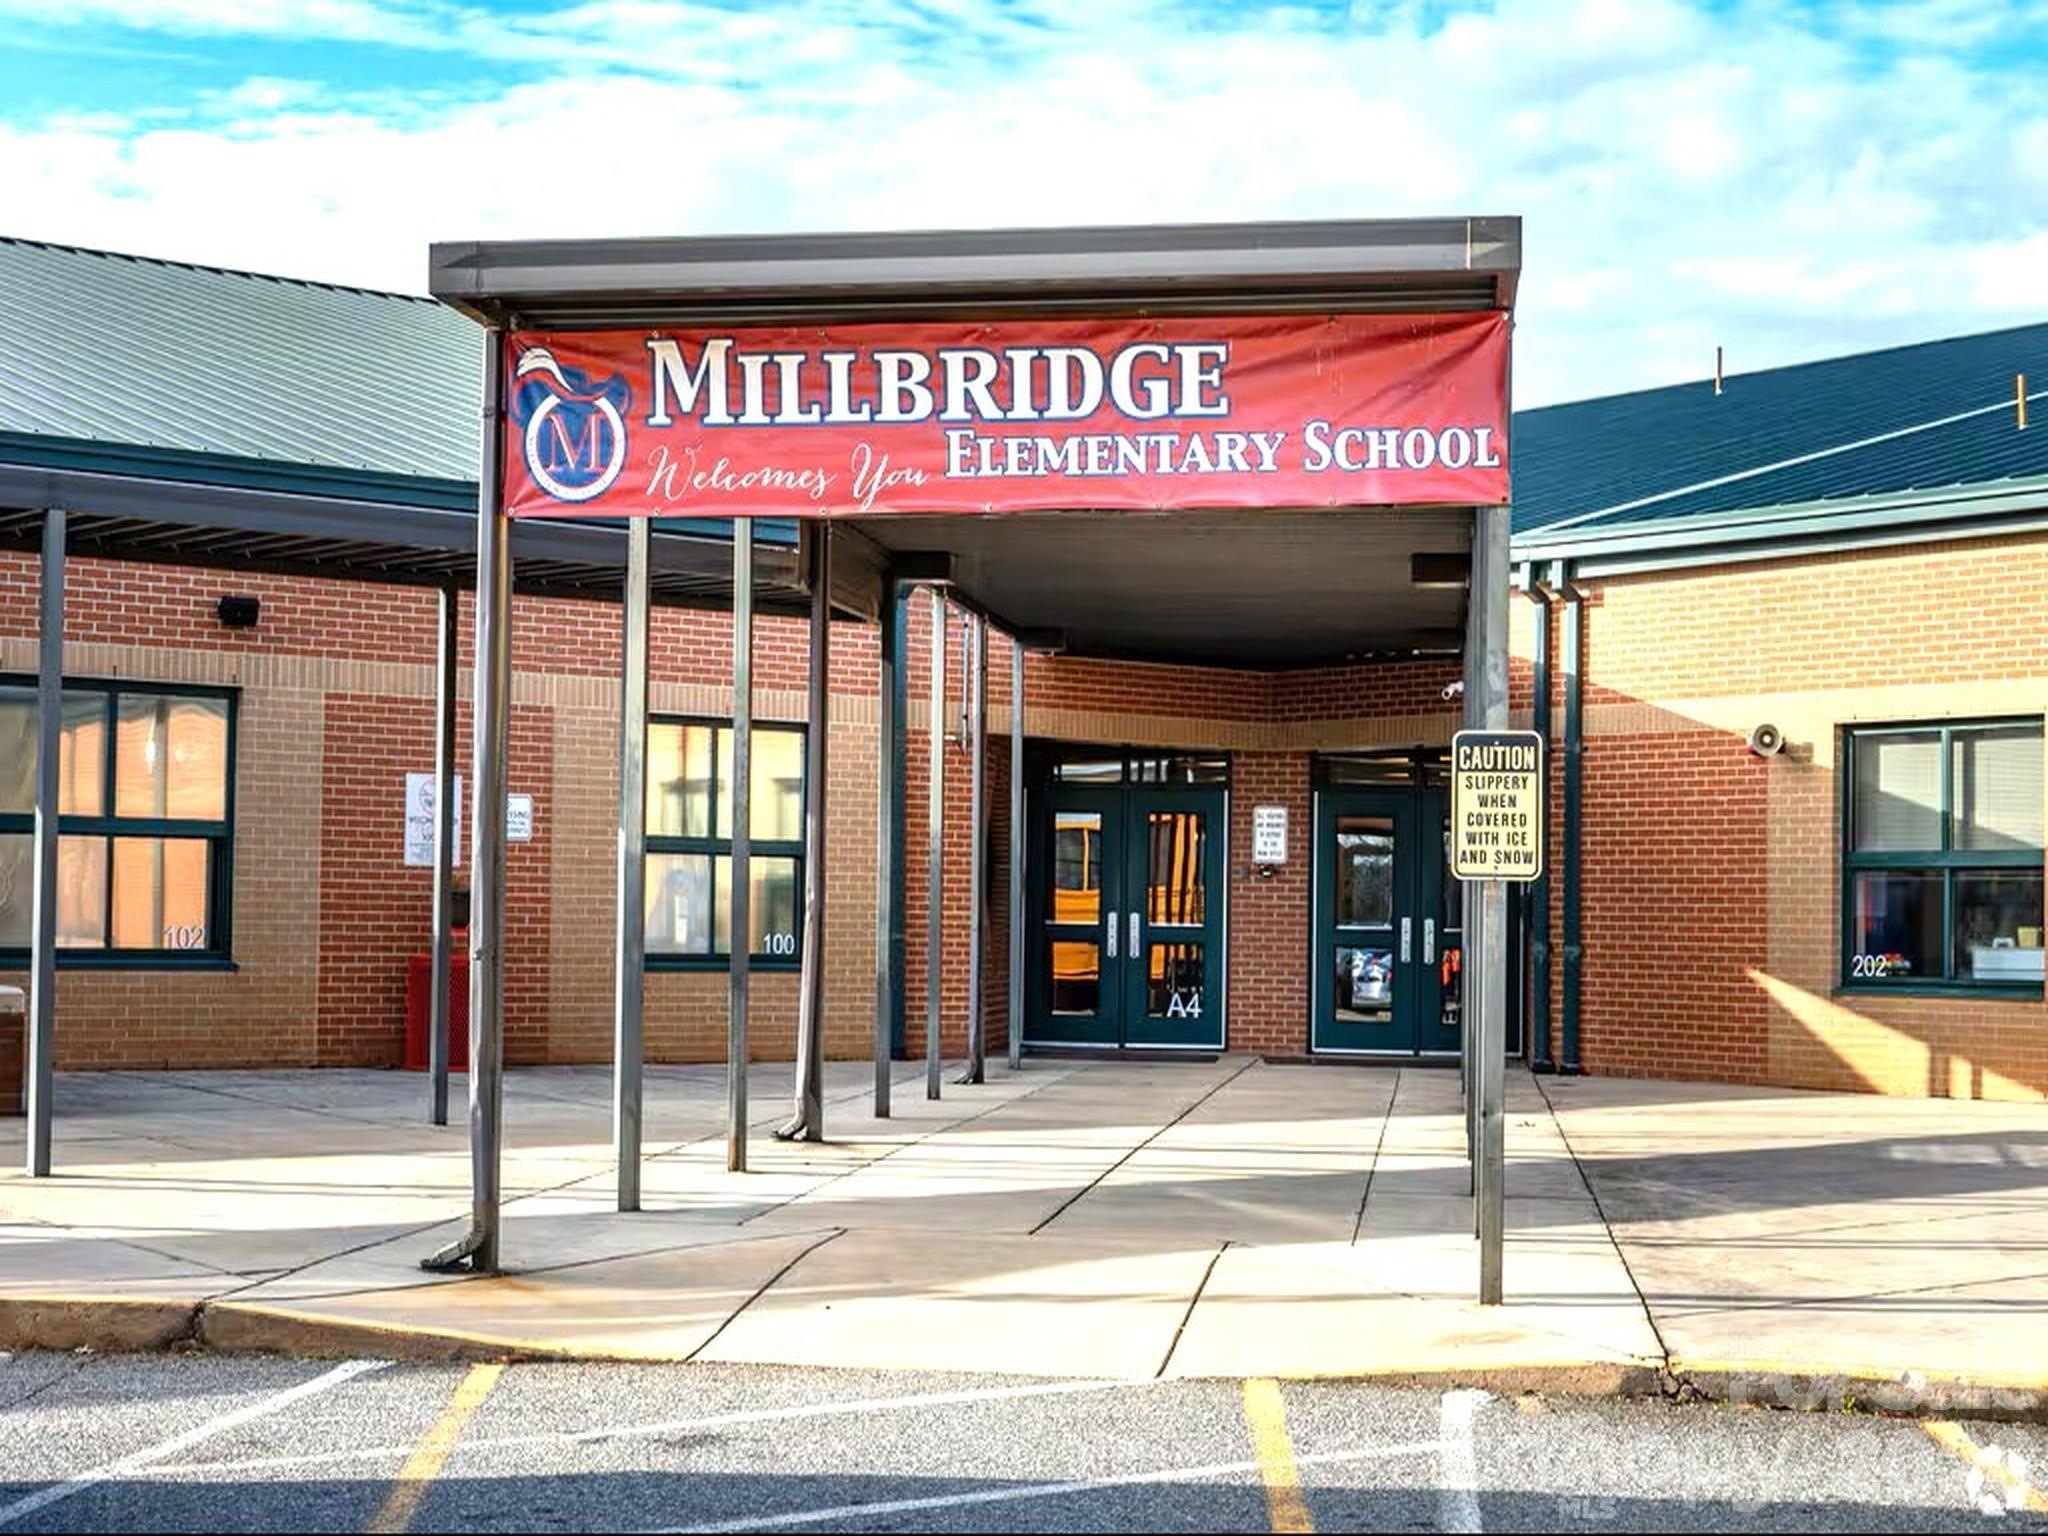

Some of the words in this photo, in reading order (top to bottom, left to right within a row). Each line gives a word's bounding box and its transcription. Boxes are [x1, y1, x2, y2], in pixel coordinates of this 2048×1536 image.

[645, 337, 1231, 427] MILLBRIDGE
[544, 412, 606, 473] M
[944, 428, 1287, 479] ELEMENTARY
[1303, 420, 1500, 473] SCHOOL
[644, 442, 839, 501] Welcomes
[850, 442, 930, 512] You
[1459, 745, 1535, 770] CAUTION
[1465, 775, 1529, 790] SLIPPERY
[1477, 794, 1517, 808] WHEN
[1466, 812, 1527, 827] COVERED
[1465, 831, 1500, 846] WITH
[1506, 831, 1528, 846] ICE
[1459, 850, 1487, 865] AND
[1493, 850, 1533, 865] SNOW
[164, 925, 206, 950] 102
[763, 933, 795, 954] 100
[1852, 954, 1888, 977] 202
[1166, 992, 1204, 1019] A4
